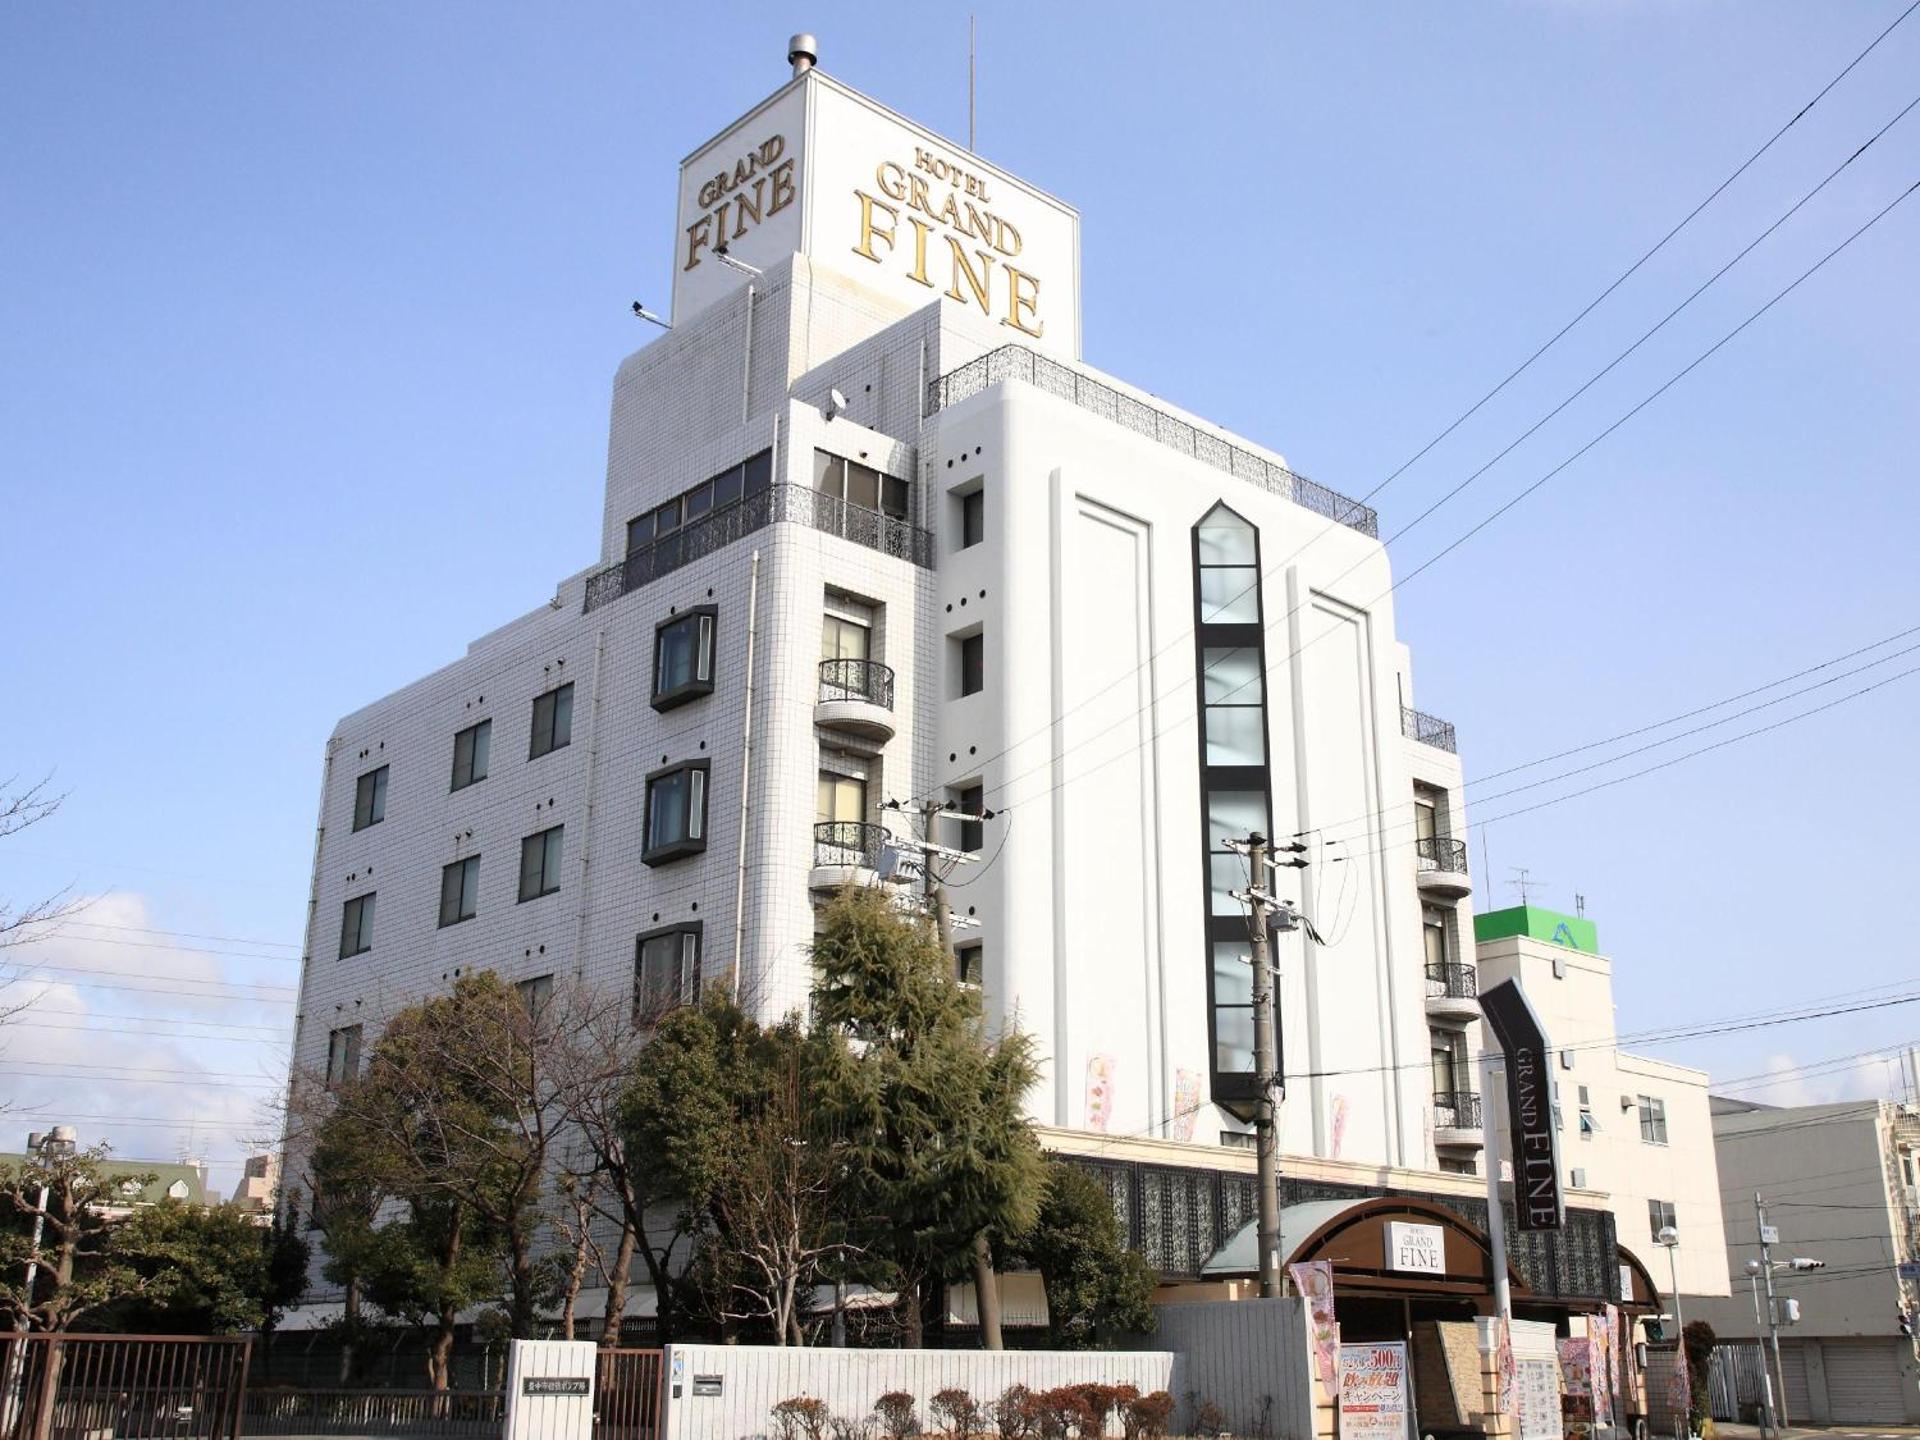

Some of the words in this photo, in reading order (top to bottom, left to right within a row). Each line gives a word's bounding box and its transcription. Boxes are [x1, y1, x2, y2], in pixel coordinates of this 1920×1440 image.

[698, 134, 785, 211] GRAND
[875, 159, 1023, 258] GRAND
[914, 145, 992, 204] HOTEL
[683, 157, 796, 273] FINE
[851, 188, 1045, 340] FINE
[1517, 1047, 1537, 1127] GRAND
[1524, 1130, 1556, 1227] FINE
[1400, 1247, 1438, 1268] FINE
[1402, 1234, 1433, 1248] GRAND
[1343, 1389, 1401, 1402] キャンペーン
